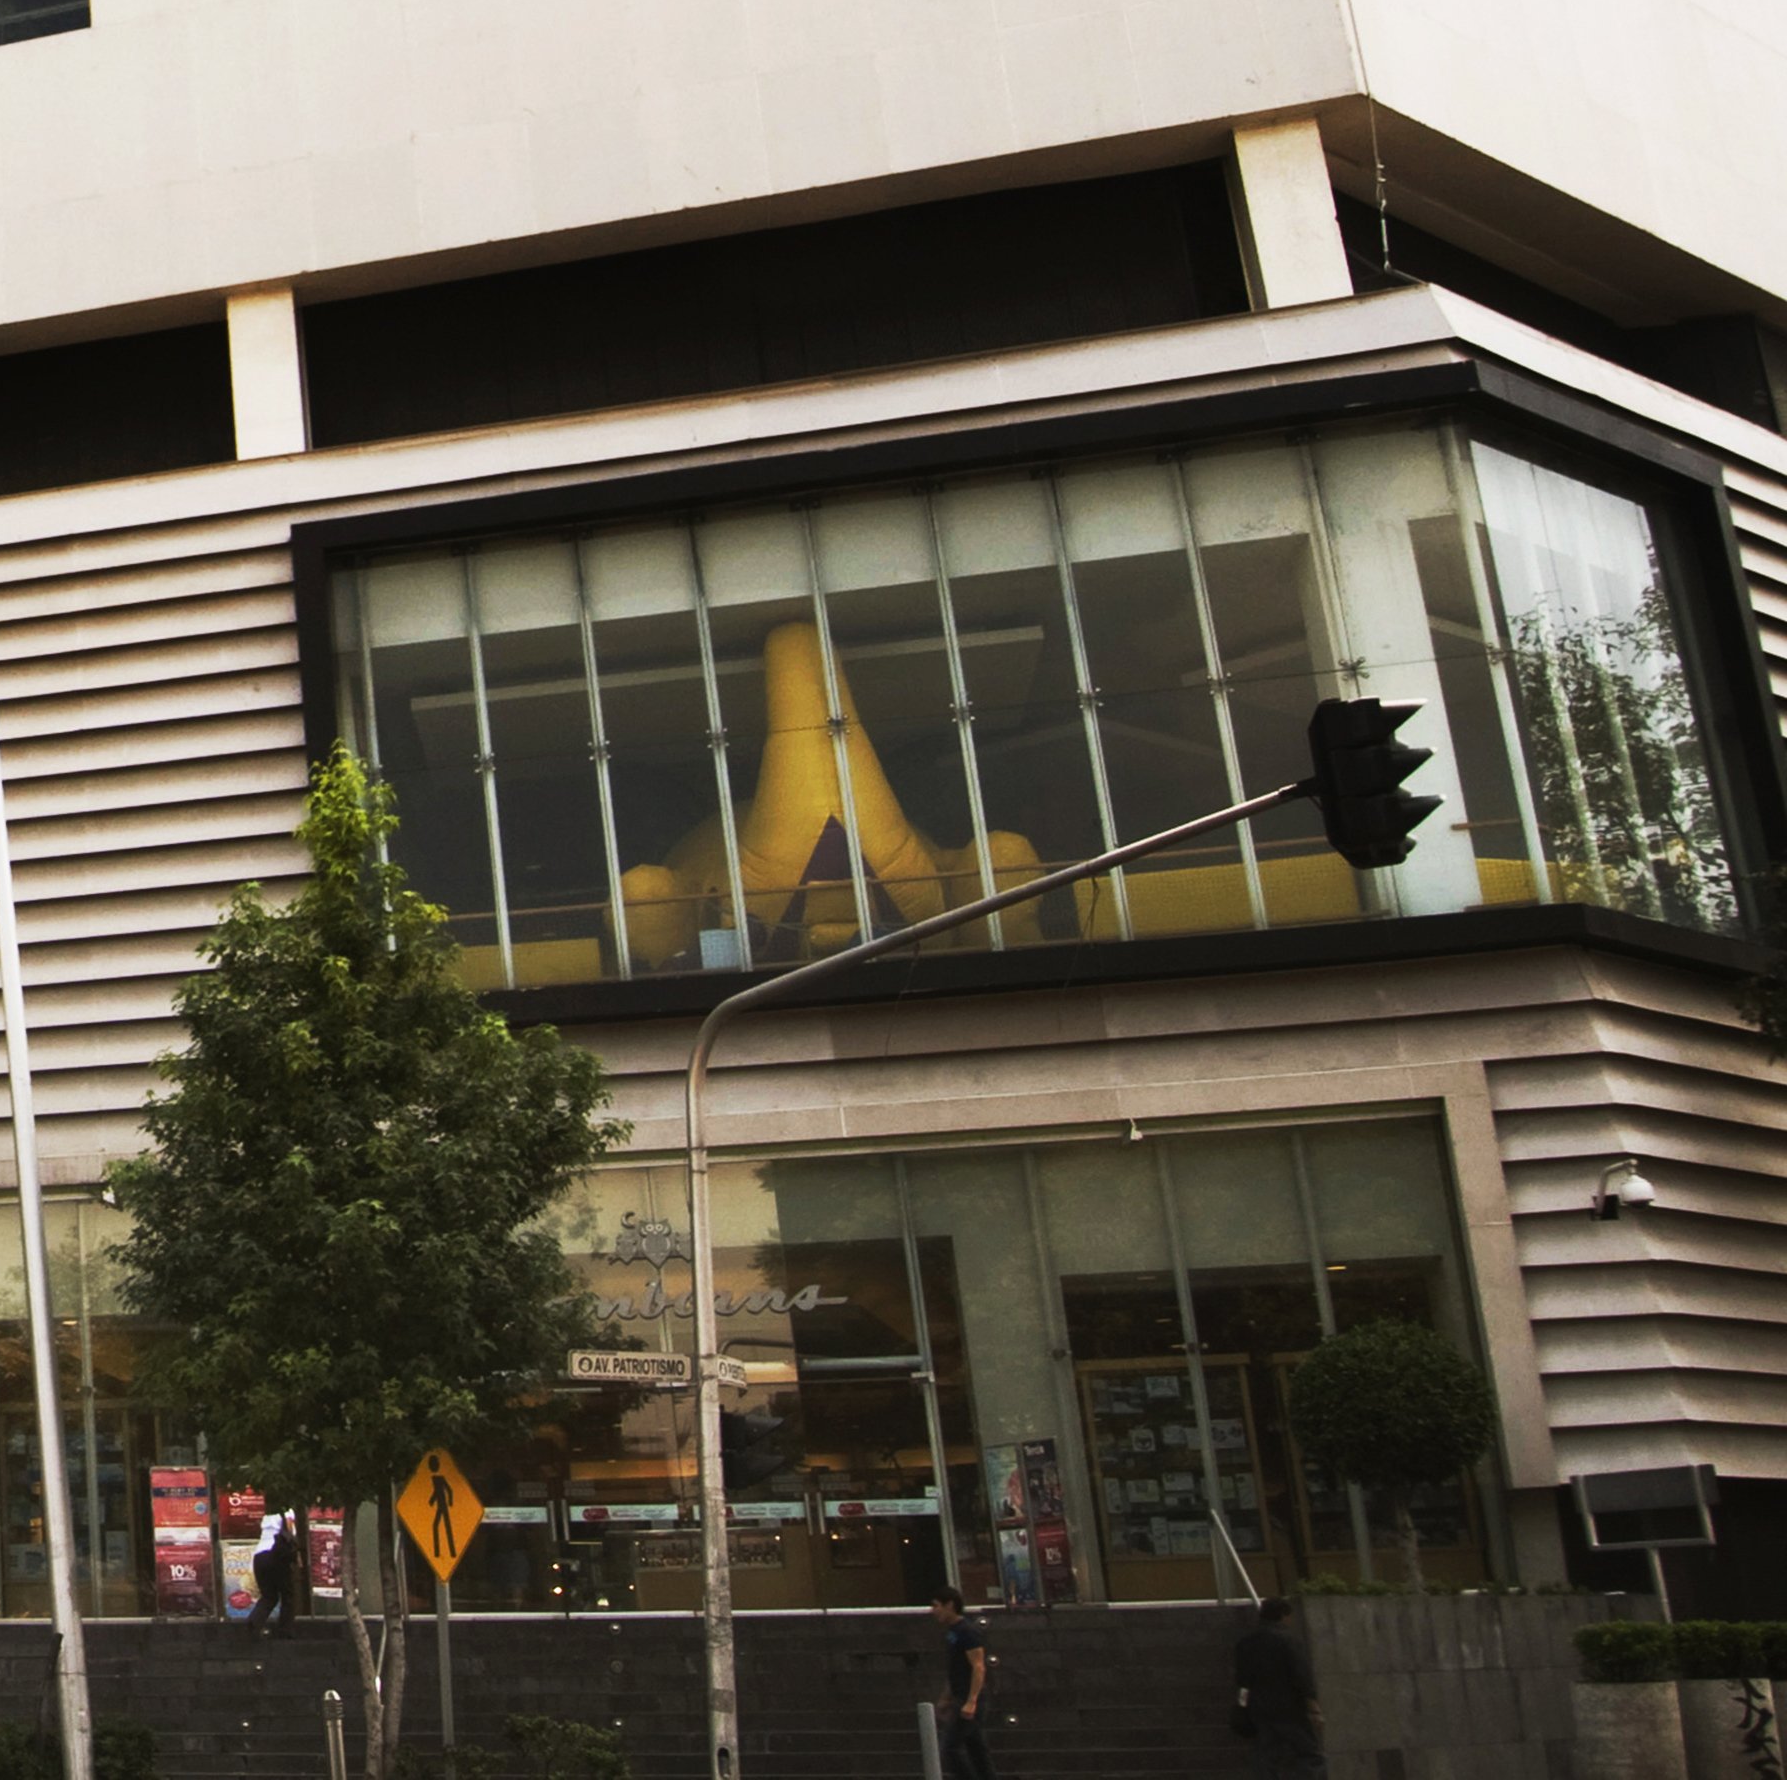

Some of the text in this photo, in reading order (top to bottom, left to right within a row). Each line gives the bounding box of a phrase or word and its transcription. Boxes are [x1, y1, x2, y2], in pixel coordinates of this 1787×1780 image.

[593, 1356, 686, 1377] AV. PATRIOTISMO
[169, 1564, 197, 1578] 10%
